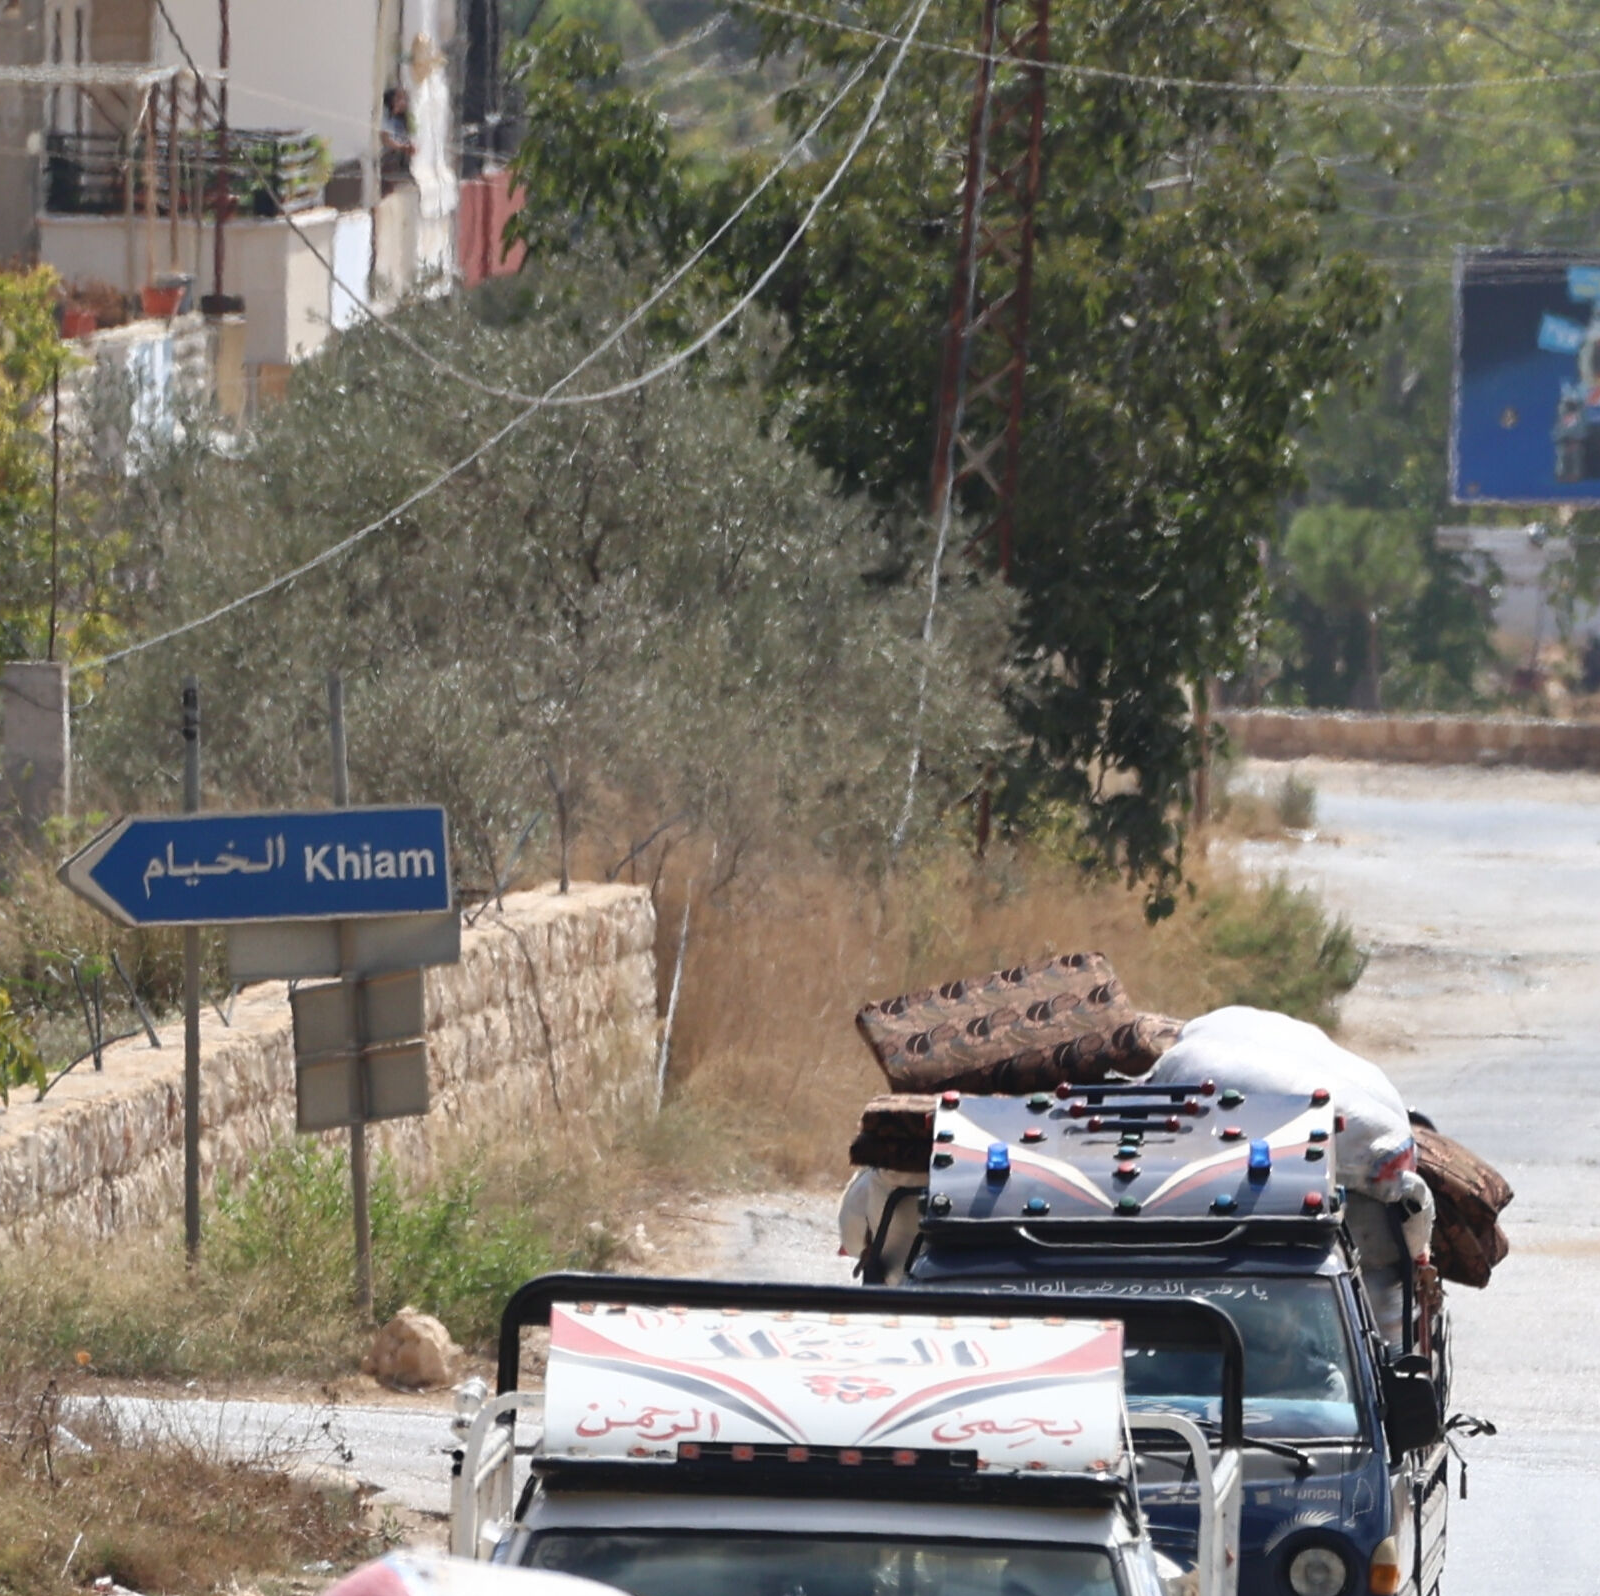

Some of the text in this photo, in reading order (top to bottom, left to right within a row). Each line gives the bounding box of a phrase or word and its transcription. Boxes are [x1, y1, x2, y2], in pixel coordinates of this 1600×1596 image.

[143, 832, 286, 900] الخيام
[304, 843, 435, 883] Khiam
[1148, 1281, 1185, 1295] الله
[575, 1397, 721, 1442] الرحمن
